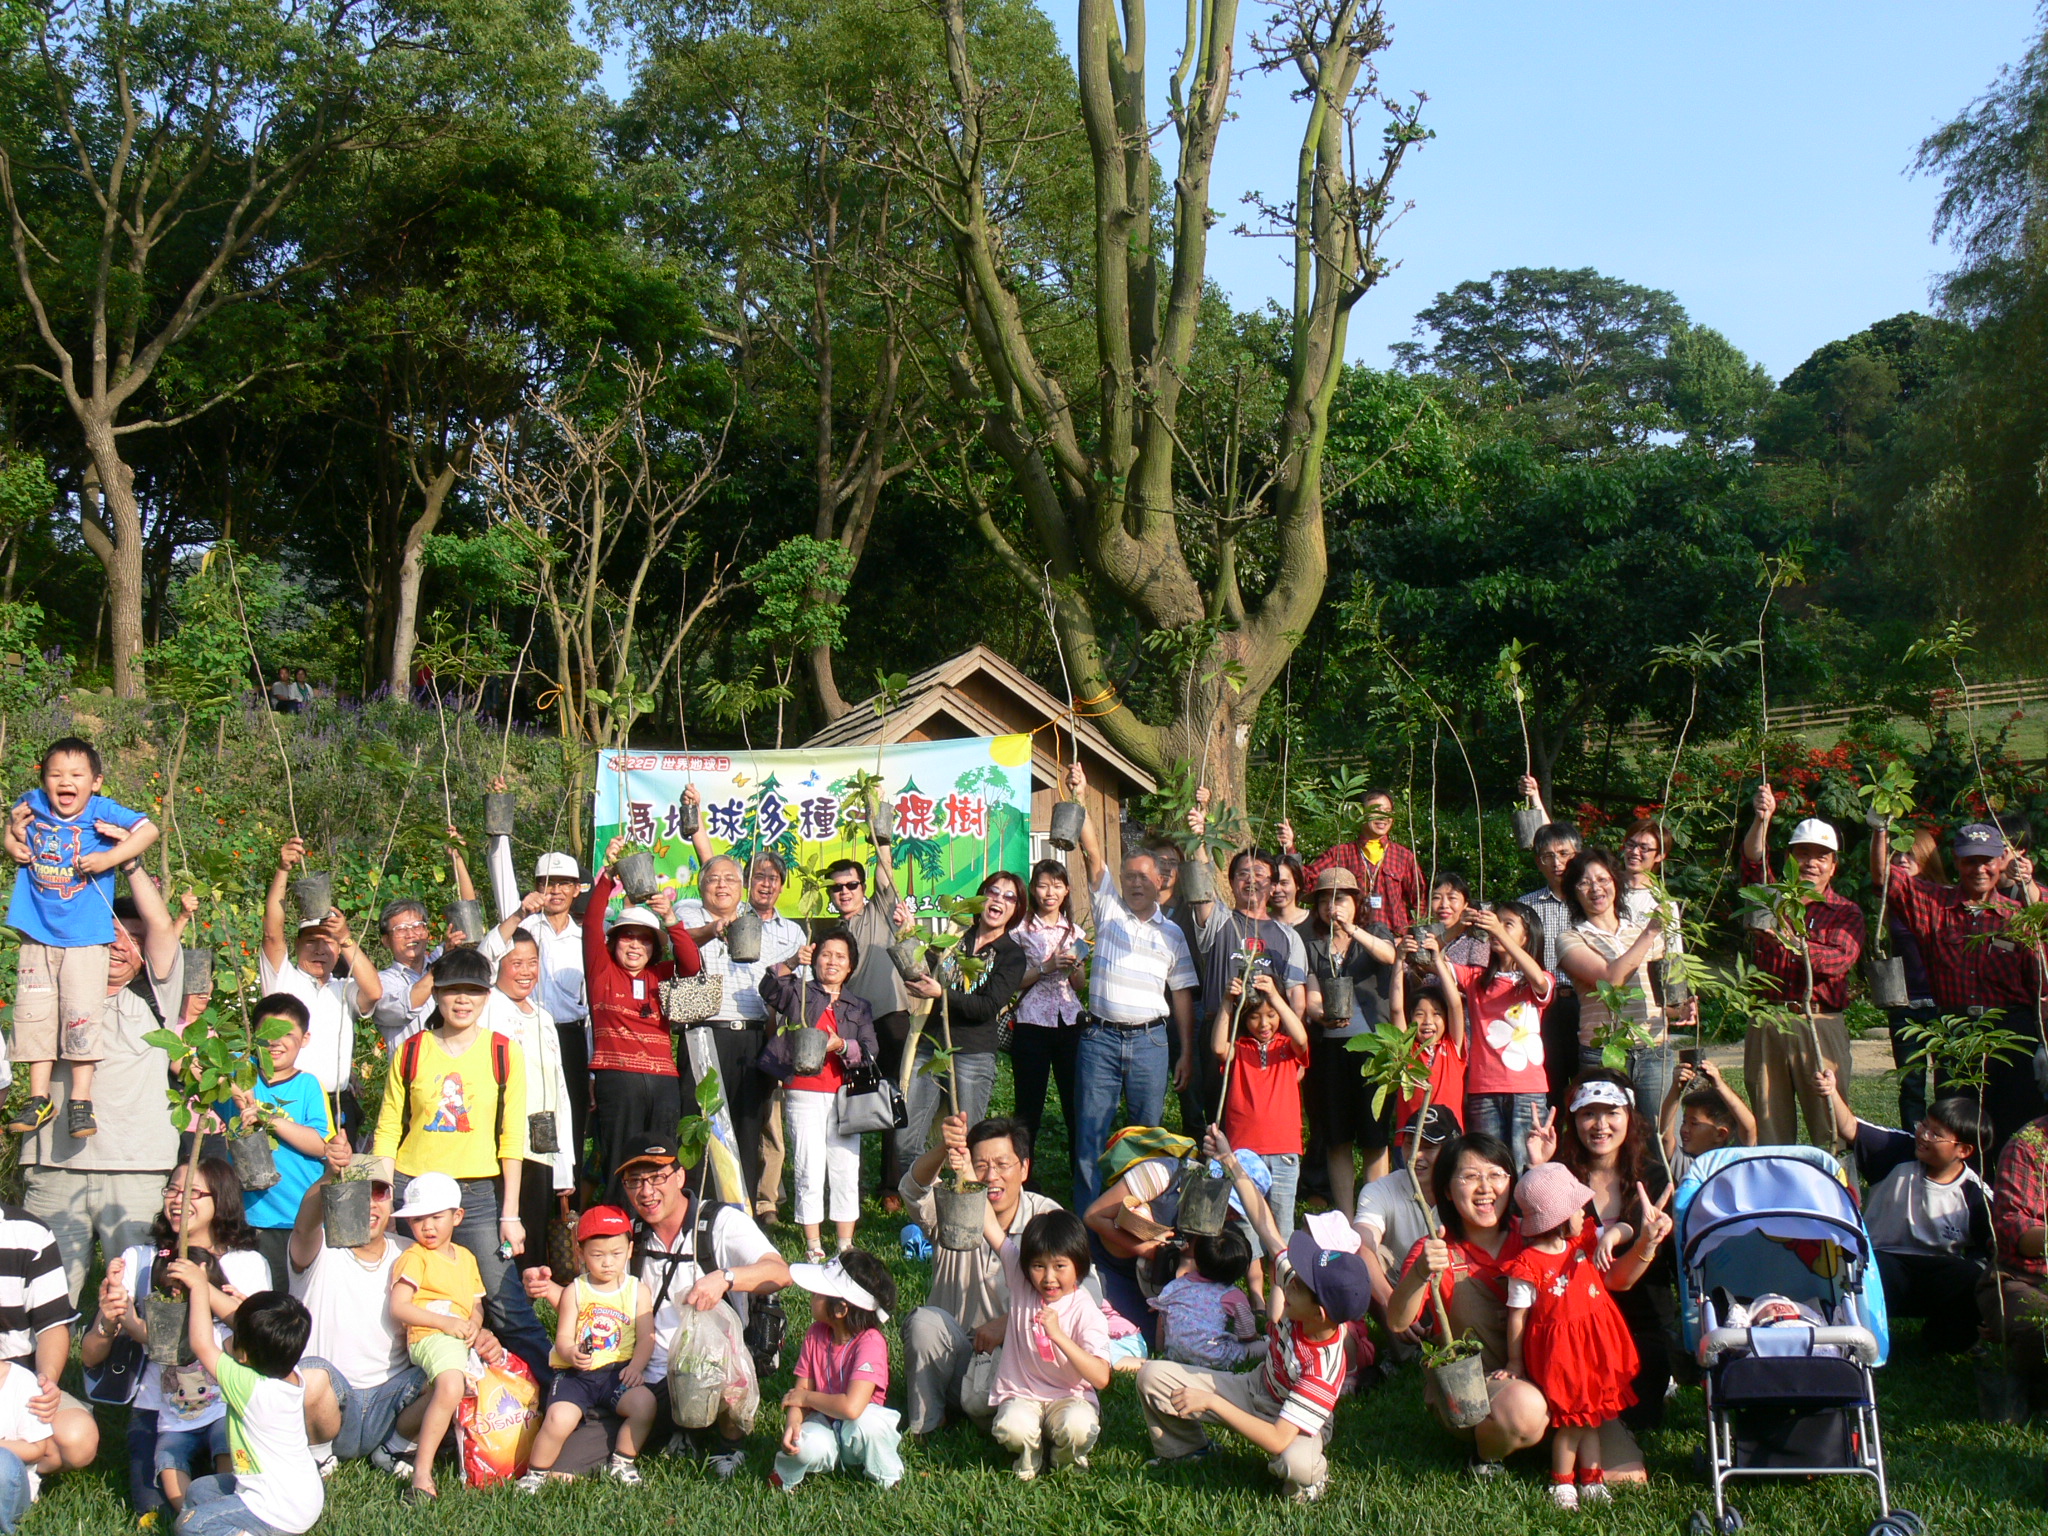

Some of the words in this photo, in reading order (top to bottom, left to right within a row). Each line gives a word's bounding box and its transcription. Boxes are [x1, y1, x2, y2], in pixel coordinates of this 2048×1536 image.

[662, 756, 730, 771] 世界地球日
[33, 863, 74, 877] THOMAS
